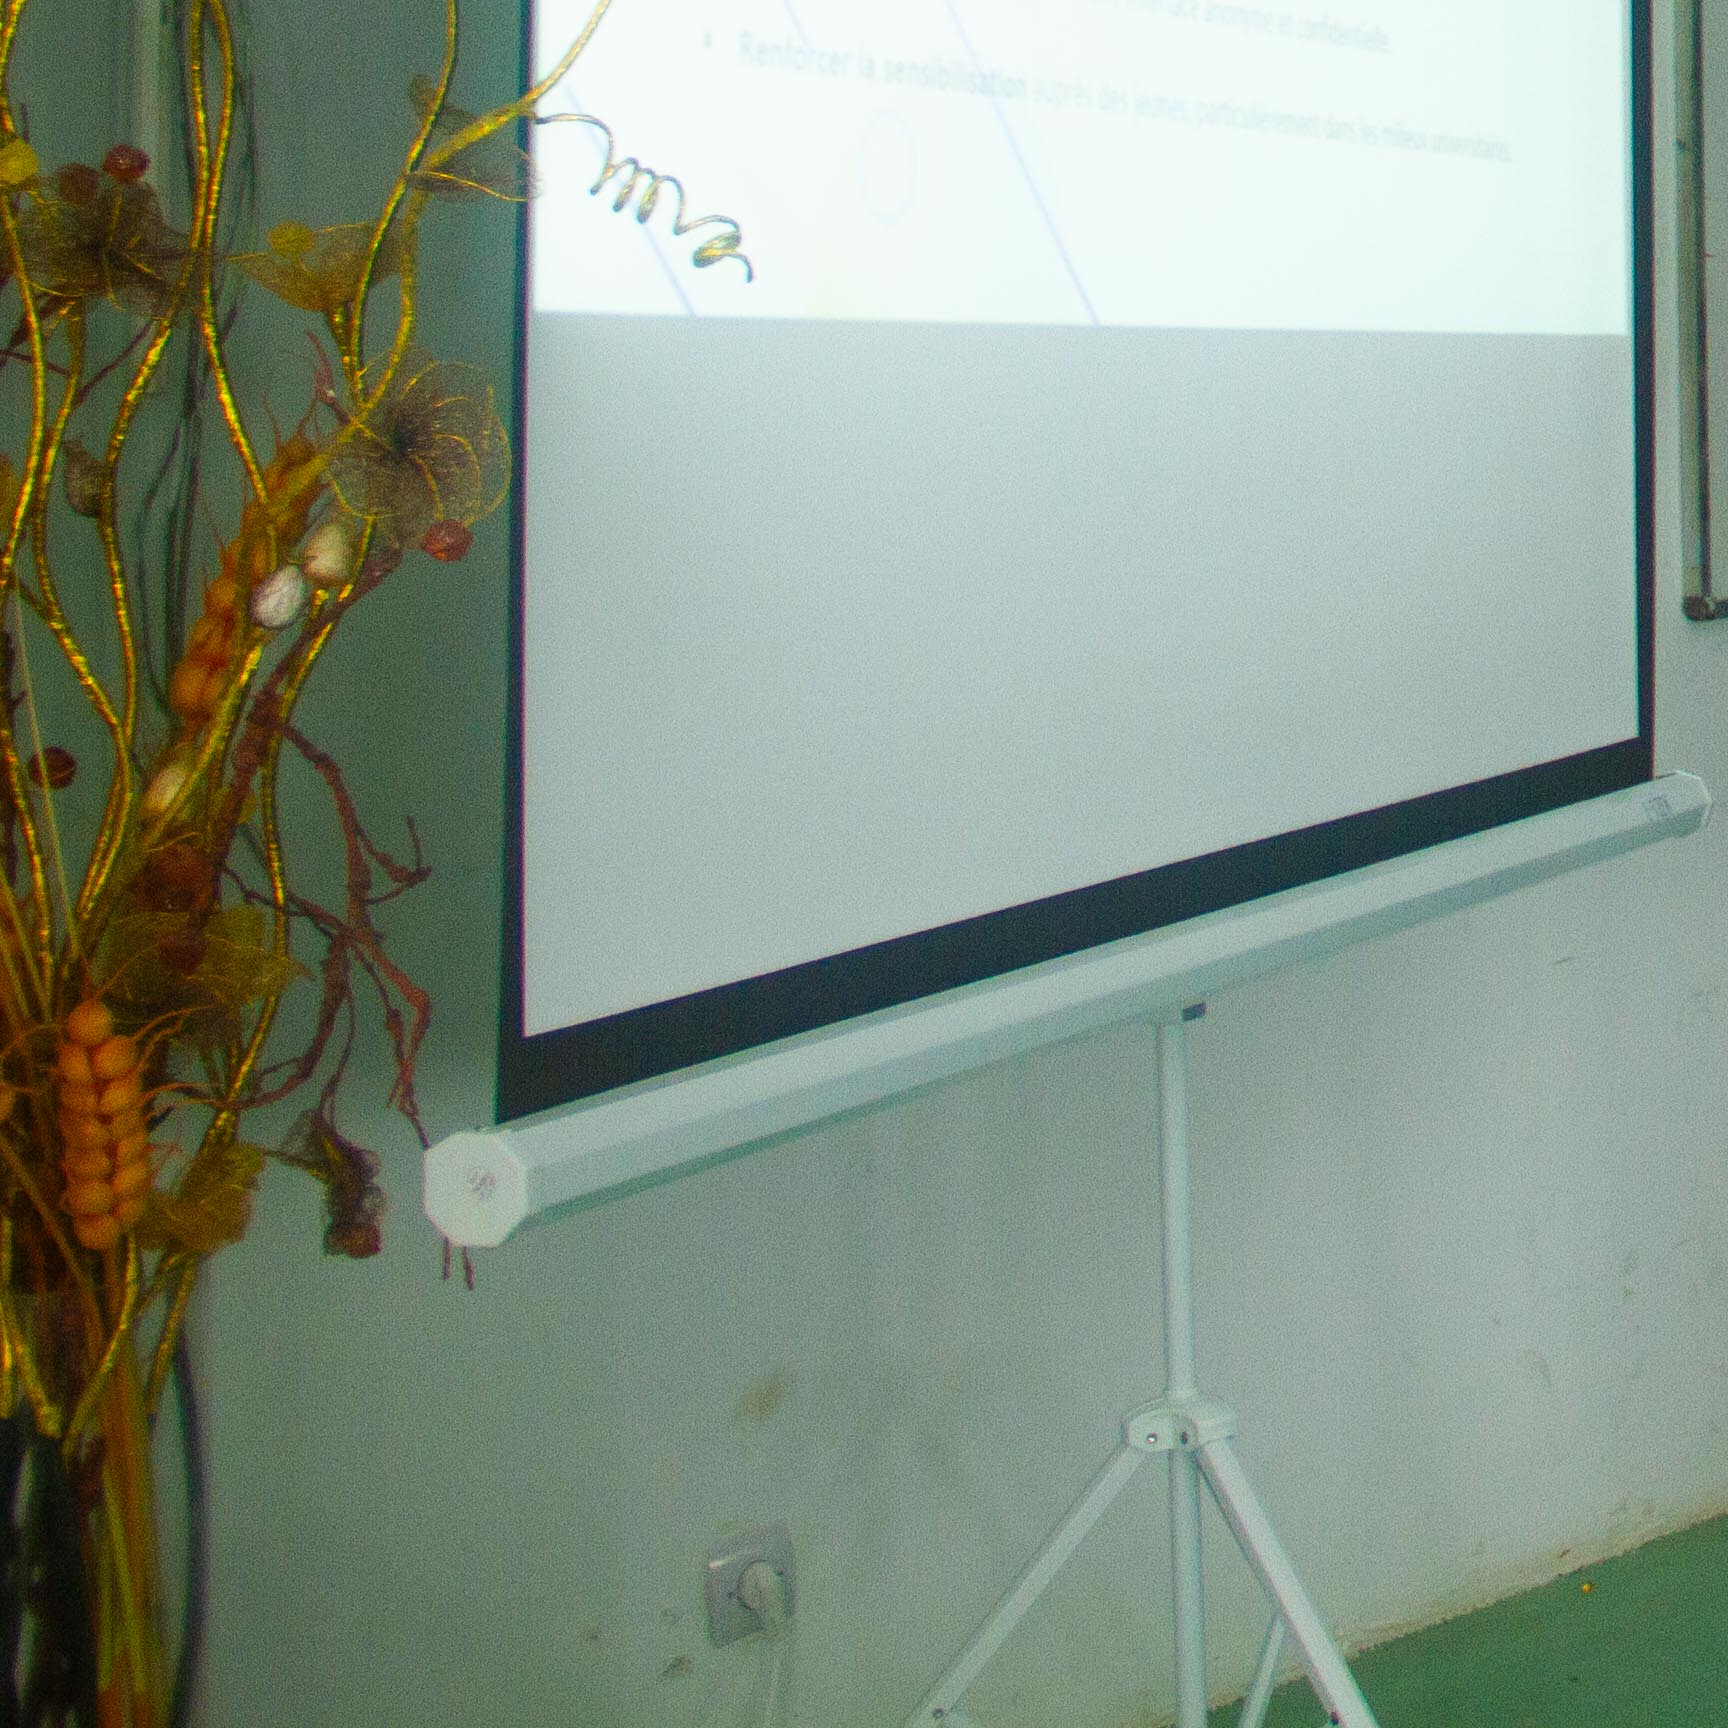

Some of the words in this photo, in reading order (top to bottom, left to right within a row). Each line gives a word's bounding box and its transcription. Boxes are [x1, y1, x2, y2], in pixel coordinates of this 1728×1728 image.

[739, 29, 849, 76] Renforcer
[858, 54, 876, 82] la
[884, 58, 1027, 100] sensibilisation
